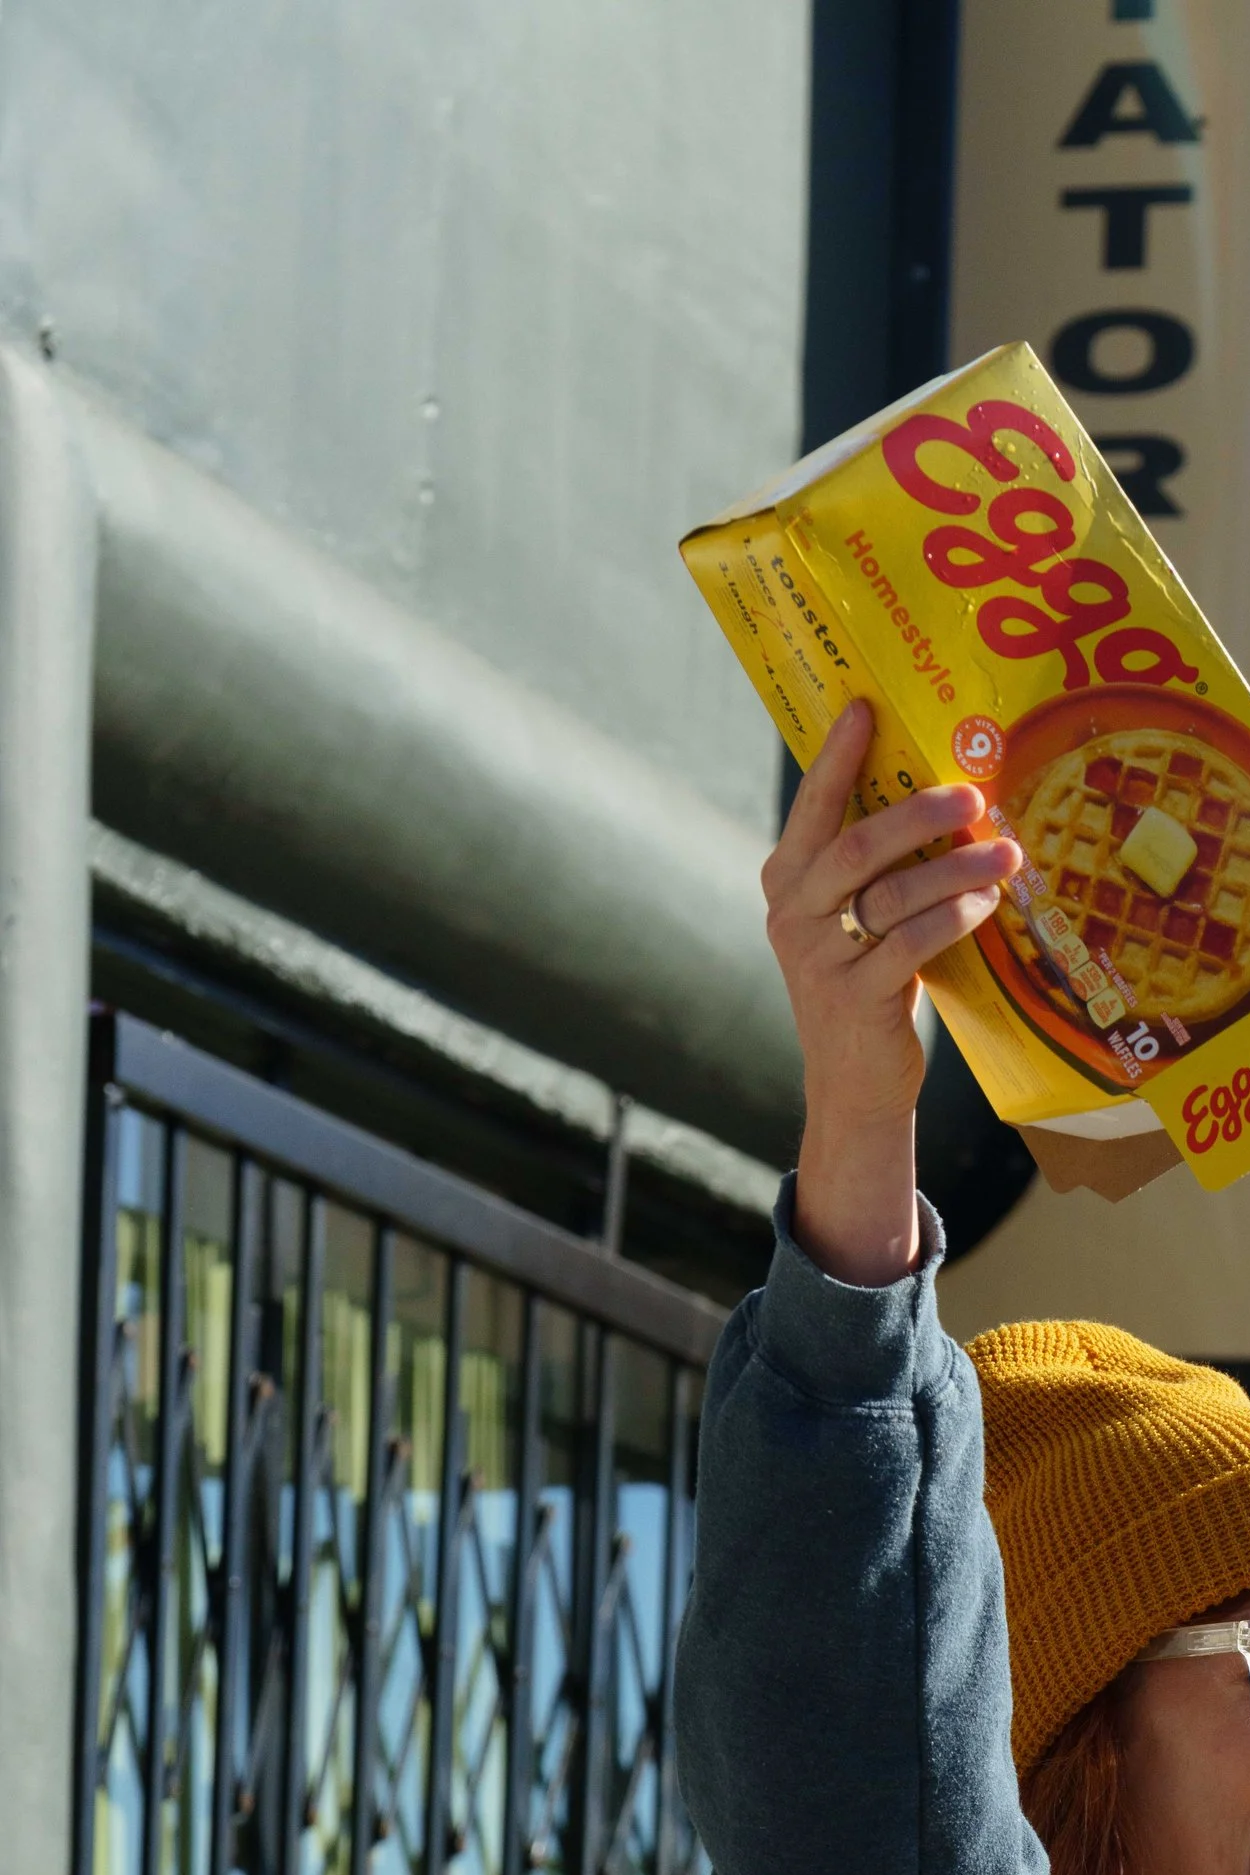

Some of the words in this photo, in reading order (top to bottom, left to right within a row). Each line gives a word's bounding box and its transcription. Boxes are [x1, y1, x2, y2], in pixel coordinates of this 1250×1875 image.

[882, 400, 1199, 690] Eggo
[743, 551, 781, 609] place
[781, 628, 797, 647] 2.
[792, 647, 826, 692] heat
[767, 553, 852, 673] toaster
[844, 528, 956, 705] Homestyle
[716, 560, 732, 579] 3.
[724, 579, 762, 636] laugh
[762, 662, 778, 681] 4.
[772, 682, 808, 737] enjoy
[955, 729, 983, 773] MINERALS
[964, 732, 991, 757] 9
[976, 719, 1002, 760] VITAMINS
[987, 804, 1012, 836] NET
[1023, 867, 1047, 896] NETO
[1005, 872, 1034, 907] (349g)
[1046, 909, 1069, 935] 180
[1097, 952, 1113, 971] PER
[1111, 973, 1138, 1008] WAFFLES
[1106, 1030, 1142, 1080] WAFFLES
[1121, 1019, 1163, 1065] 10
